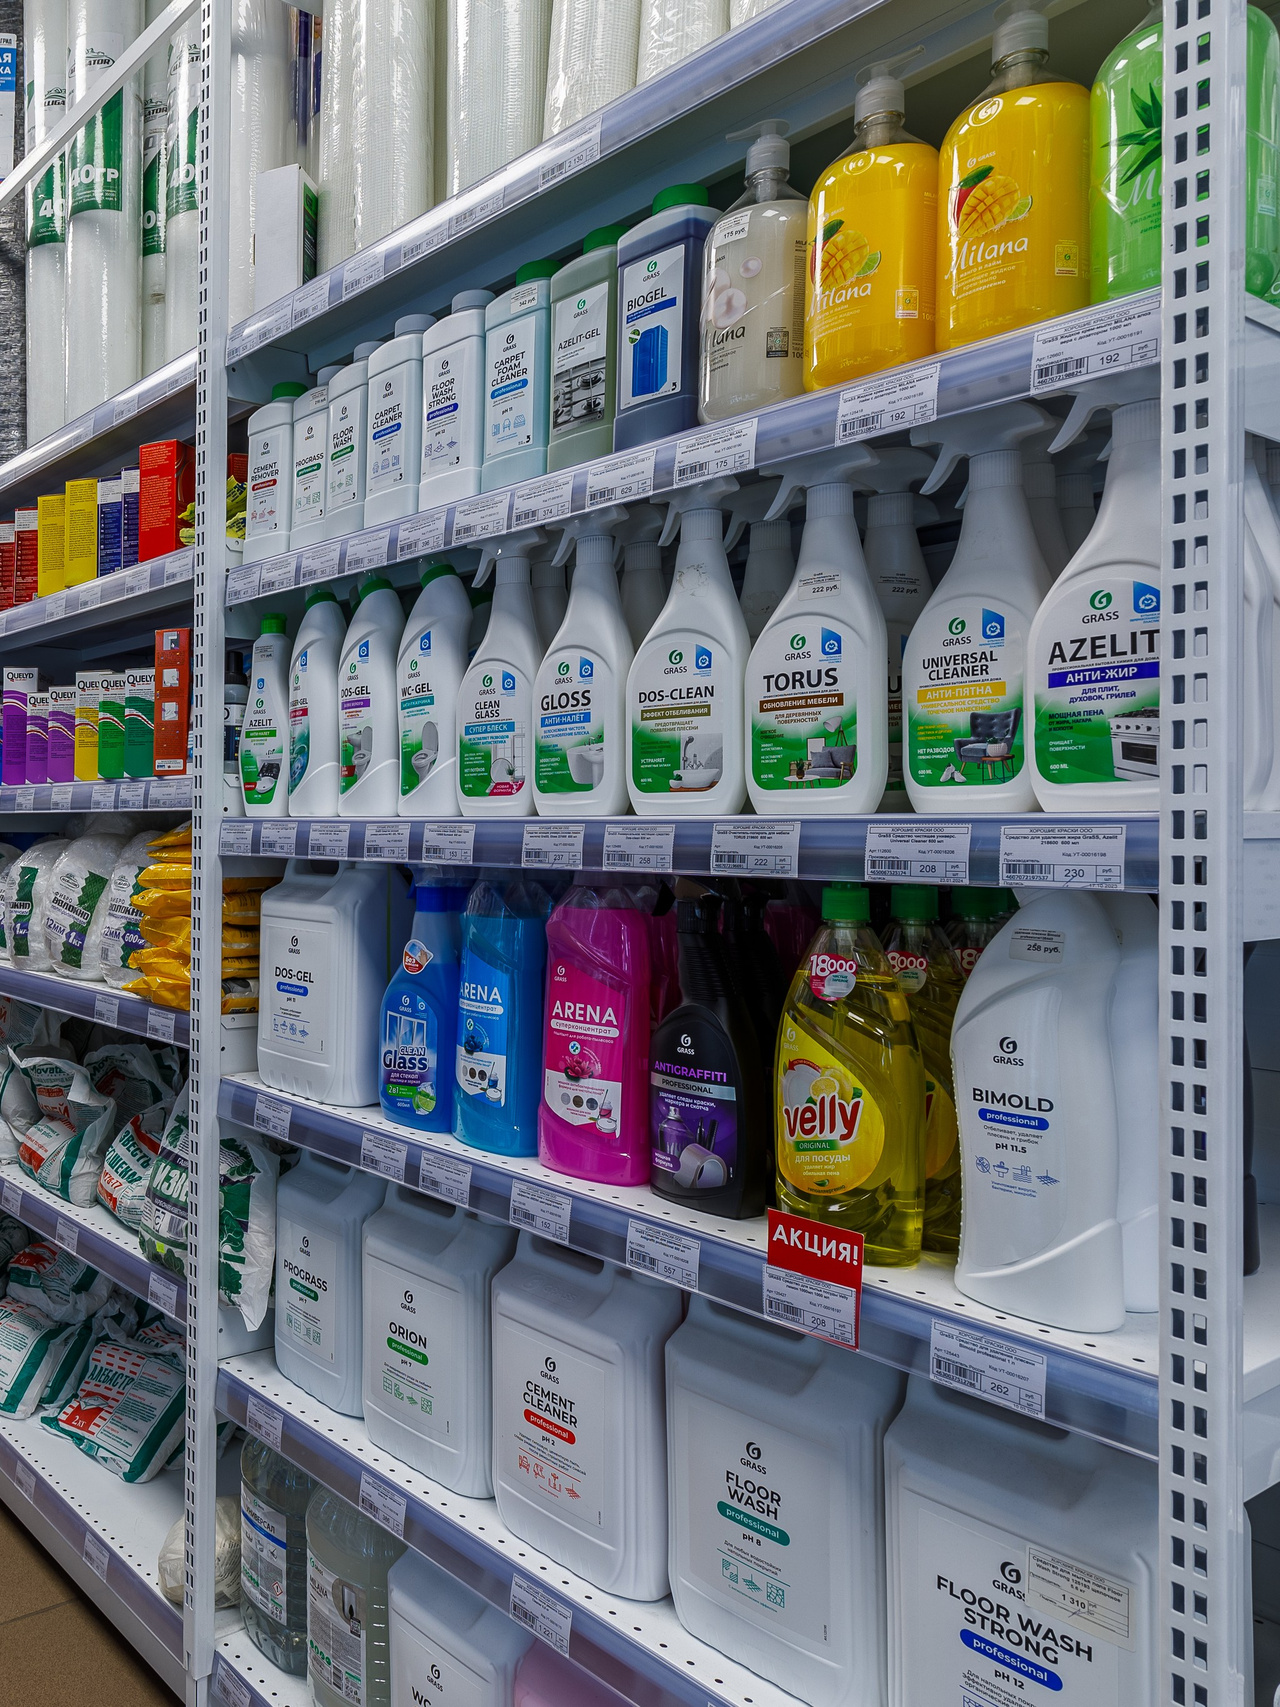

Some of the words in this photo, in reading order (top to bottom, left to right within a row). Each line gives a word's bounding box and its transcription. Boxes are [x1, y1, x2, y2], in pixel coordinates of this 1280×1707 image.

[723, 230, 734, 239] 175
[945, 237, 1029, 280] Milana
[642, 270, 661, 282] GRASS
[627, 287, 668, 312] BIOGEL
[557, 328, 601, 352] AZELIT-GEL
[494, 351, 526, 370] CARPET
[1099, 353, 1120, 366] 192
[497, 362, 521, 377] FOAM
[431, 378, 455, 393] FLOOR
[491, 368, 528, 388] CLEANER
[431, 386, 454, 400] WASH
[493, 381, 523, 397] professional
[428, 393, 457, 410] STRONG
[374, 403, 401, 420] CARPET
[889, 411, 906, 422] 192
[372, 412, 403, 430] CLEANER
[332, 425, 354, 442] FLOOR
[332, 435, 352, 449] WASH
[253, 461, 278, 474] CEMENT
[295, 452, 324, 469] PROGRASS
[715, 459, 728, 469] 175
[250, 469, 279, 482] REMOVER
[620, 486, 633, 495] 629
[542, 509, 553, 517] 374
[812, 585, 824, 593] 222
[825, 584, 840, 593] руб.
[892, 586, 904, 594] 222
[1081, 610, 1120, 625] GRASS
[942, 635, 972, 647] GRASS
[1048, 629, 1160, 666] AZELIT
[784, 650, 812, 661] GRASS
[922, 650, 998, 670] UNIVERSAL
[6, 671, 34, 683] QUELYD
[663, 665, 688, 675] GRASS
[928, 664, 990, 682] CLEANER
[1065, 666, 1138, 684] АНТИ-ЖИР
[554, 676, 573, 685] GRASS
[763, 667, 839, 693] TORUS
[340, 685, 371, 699] DOS-GEL
[401, 683, 433, 697] WC-GEL
[478, 688, 496, 696] GRASS
[638, 685, 715, 704] DOS-CLEAN
[926, 684, 993, 701] АНТИ-ПЯТНА
[1069, 693, 1105, 705] ДУХОВОК,
[1106, 690, 1137, 702] ГРИЛЕЙ
[1081, 687, 1098, 696] ДЛЯ
[1099, 685, 1120, 696] ПЛИТ,
[474, 700, 501, 710] CLEAN
[540, 689, 592, 712] GLOSS
[762, 698, 807, 710] ОБНОВЛЕНИЕ
[807, 696, 838, 706] МЕБЕЛИ
[920, 699, 967, 710] УНИВЕРСАЛЬНОЕ
[967, 697, 1000, 707] СРЕДСТВО
[475, 709, 500, 720] GLASS
[643, 709, 665, 719] ЭФФЕКТ
[665, 707, 708, 717] ОТБЕЛИВАНИЯ
[785, 710, 822, 719] ДЕРЕВЯННЫХ
[1048, 711, 1082, 720] МОЩНАЯ
[1082, 709, 1104, 718] ПЕНА
[249, 718, 273, 728] AZELIT
[468, 724, 487, 733] СУПЕР
[487, 723, 508, 732] БЛЕСК
[554, 854, 564, 863] 237
[639, 857, 651, 866] 258
[754, 858, 768, 866] 222
[919, 865, 937, 873] 208
[1064, 868, 1085, 878] 230
[1026, 943, 1042, 953] 258
[1043, 945, 1061, 954] руб.
[810, 954, 857, 977] 18000
[274, 966, 315, 984] DOS-GEL
[280, 984, 305, 995] professional
[460, 981, 503, 1004] ARENA
[552, 1000, 618, 1026] ARENA
[399, 1046, 426, 1056] CLEAN
[677, 1046, 695, 1056] GRASS
[382, 1049, 429, 1072] Glass
[992, 1055, 1025, 1067] GRASS
[654, 1060, 727, 1083] ANTIGRAFFITI
[661, 1078, 714, 1094] PROFESSIONAL
[972, 1087, 1054, 1113] BIMOLD
[783, 1093, 862, 1142] velly
[986, 1111, 1039, 1127] professional
[119, 1129, 150, 1169] ЗВЕСТЬ
[995, 1142, 1008, 1151] pH
[795, 1155, 810, 1164] для
[812, 1154, 851, 1164] посуды
[539, 1220, 551, 1229] 152
[772, 1224, 859, 1266] АКЦИЯ!
[283, 1258, 329, 1293] PROGRASS
[663, 1265, 676, 1276] 557
[400, 1303, 417, 1315] GRASS
[811, 1316, 826, 1328] 208
[388, 1321, 428, 1349] ORION
[391, 1341, 424, 1361] professional
[88, 1364, 137, 1390] АЛЕБАСТР
[540, 1370, 560, 1385] GRASS
[525, 1380, 576, 1413] CEMENT
[990, 1382, 1010, 1396] 262
[522, 1392, 578, 1429] CLEANER
[530, 1414, 569, 1439] professional
[739, 1457, 767, 1475] GRASS
[725, 1469, 782, 1508] FLOOR
[727, 1485, 779, 1521] WASH
[726, 1507, 780, 1539] professional
[742, 1532, 754, 1543] pH
[1069, 1597, 1087, 1610] 310
[936, 1573, 1011, 1625] FLOOR
[1017, 1611, 1094, 1663] WASH
[963, 1606, 1060, 1665] STRONG
[973, 1637, 1049, 1682] professional
[426, 1674, 444, 1693] GRASS
[994, 1669, 1010, 1683] pH
[1013, 1677, 1025, 1690] 12
